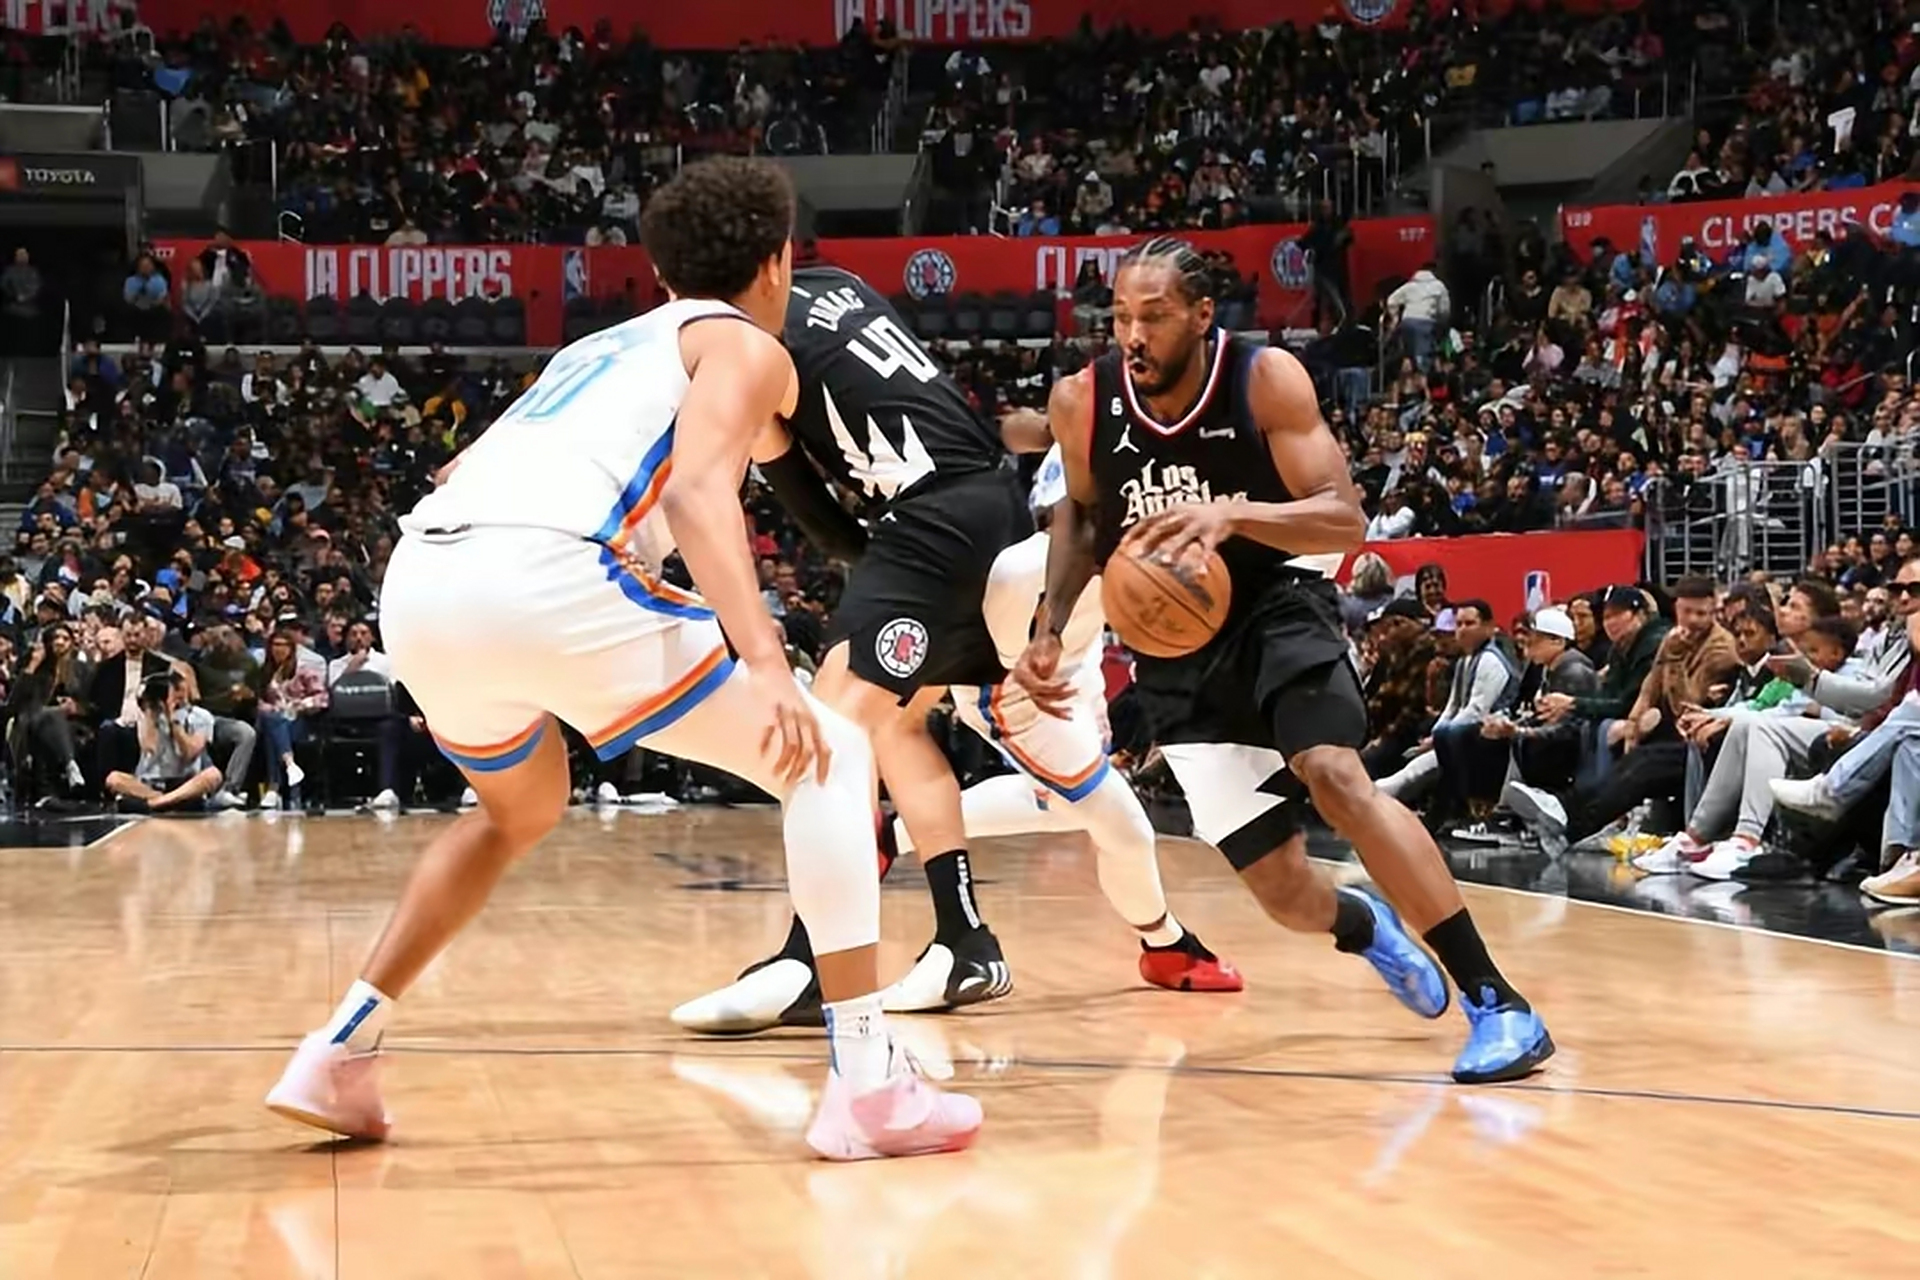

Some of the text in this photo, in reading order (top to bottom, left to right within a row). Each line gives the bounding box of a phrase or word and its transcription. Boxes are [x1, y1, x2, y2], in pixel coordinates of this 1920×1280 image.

[25, 167, 96, 184] TOYOTA
[350, 248, 512, 306] CLIPPERS
[845, 315, 940, 383] 40
[1110, 396, 1124, 416] 6
[1138, 457, 1199, 493] Los
